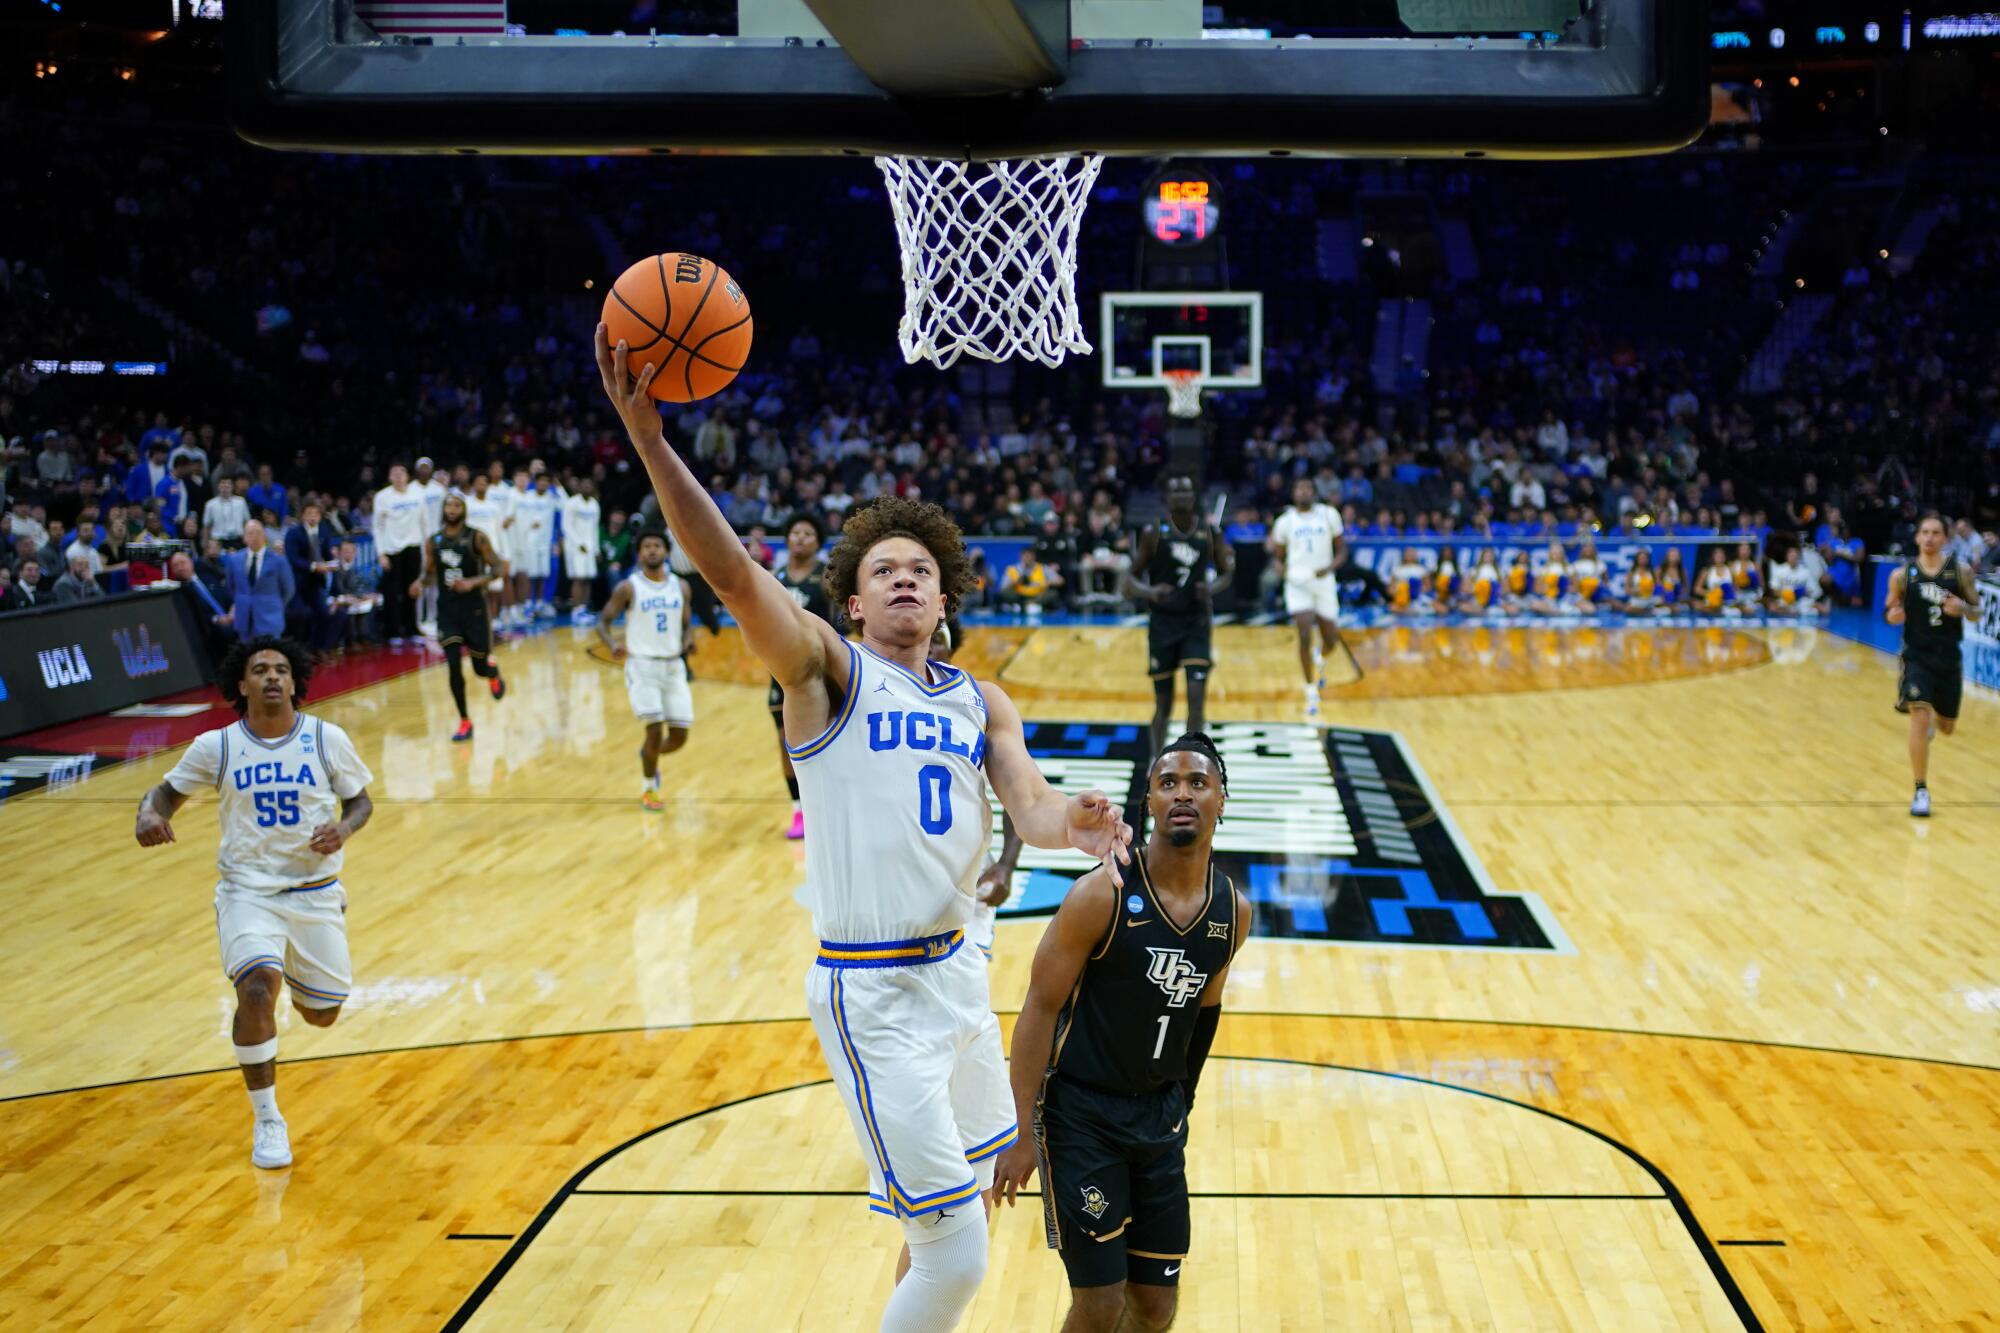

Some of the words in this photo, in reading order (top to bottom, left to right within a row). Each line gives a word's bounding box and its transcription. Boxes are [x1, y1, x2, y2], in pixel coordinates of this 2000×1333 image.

[1156, 203, 1205, 240] 27
[641, 597, 680, 612] UCLA
[656, 613, 668, 632] 2
[1928, 605, 1943, 627] 2
[38, 644, 92, 689] UCLA
[867, 711, 985, 771] UCLA
[233, 762, 316, 790] UCLA
[254, 790, 301, 827] 55
[918, 764, 953, 835] 0
[1146, 946, 1208, 1008] UCF
[1152, 1015, 1171, 1059] 1
